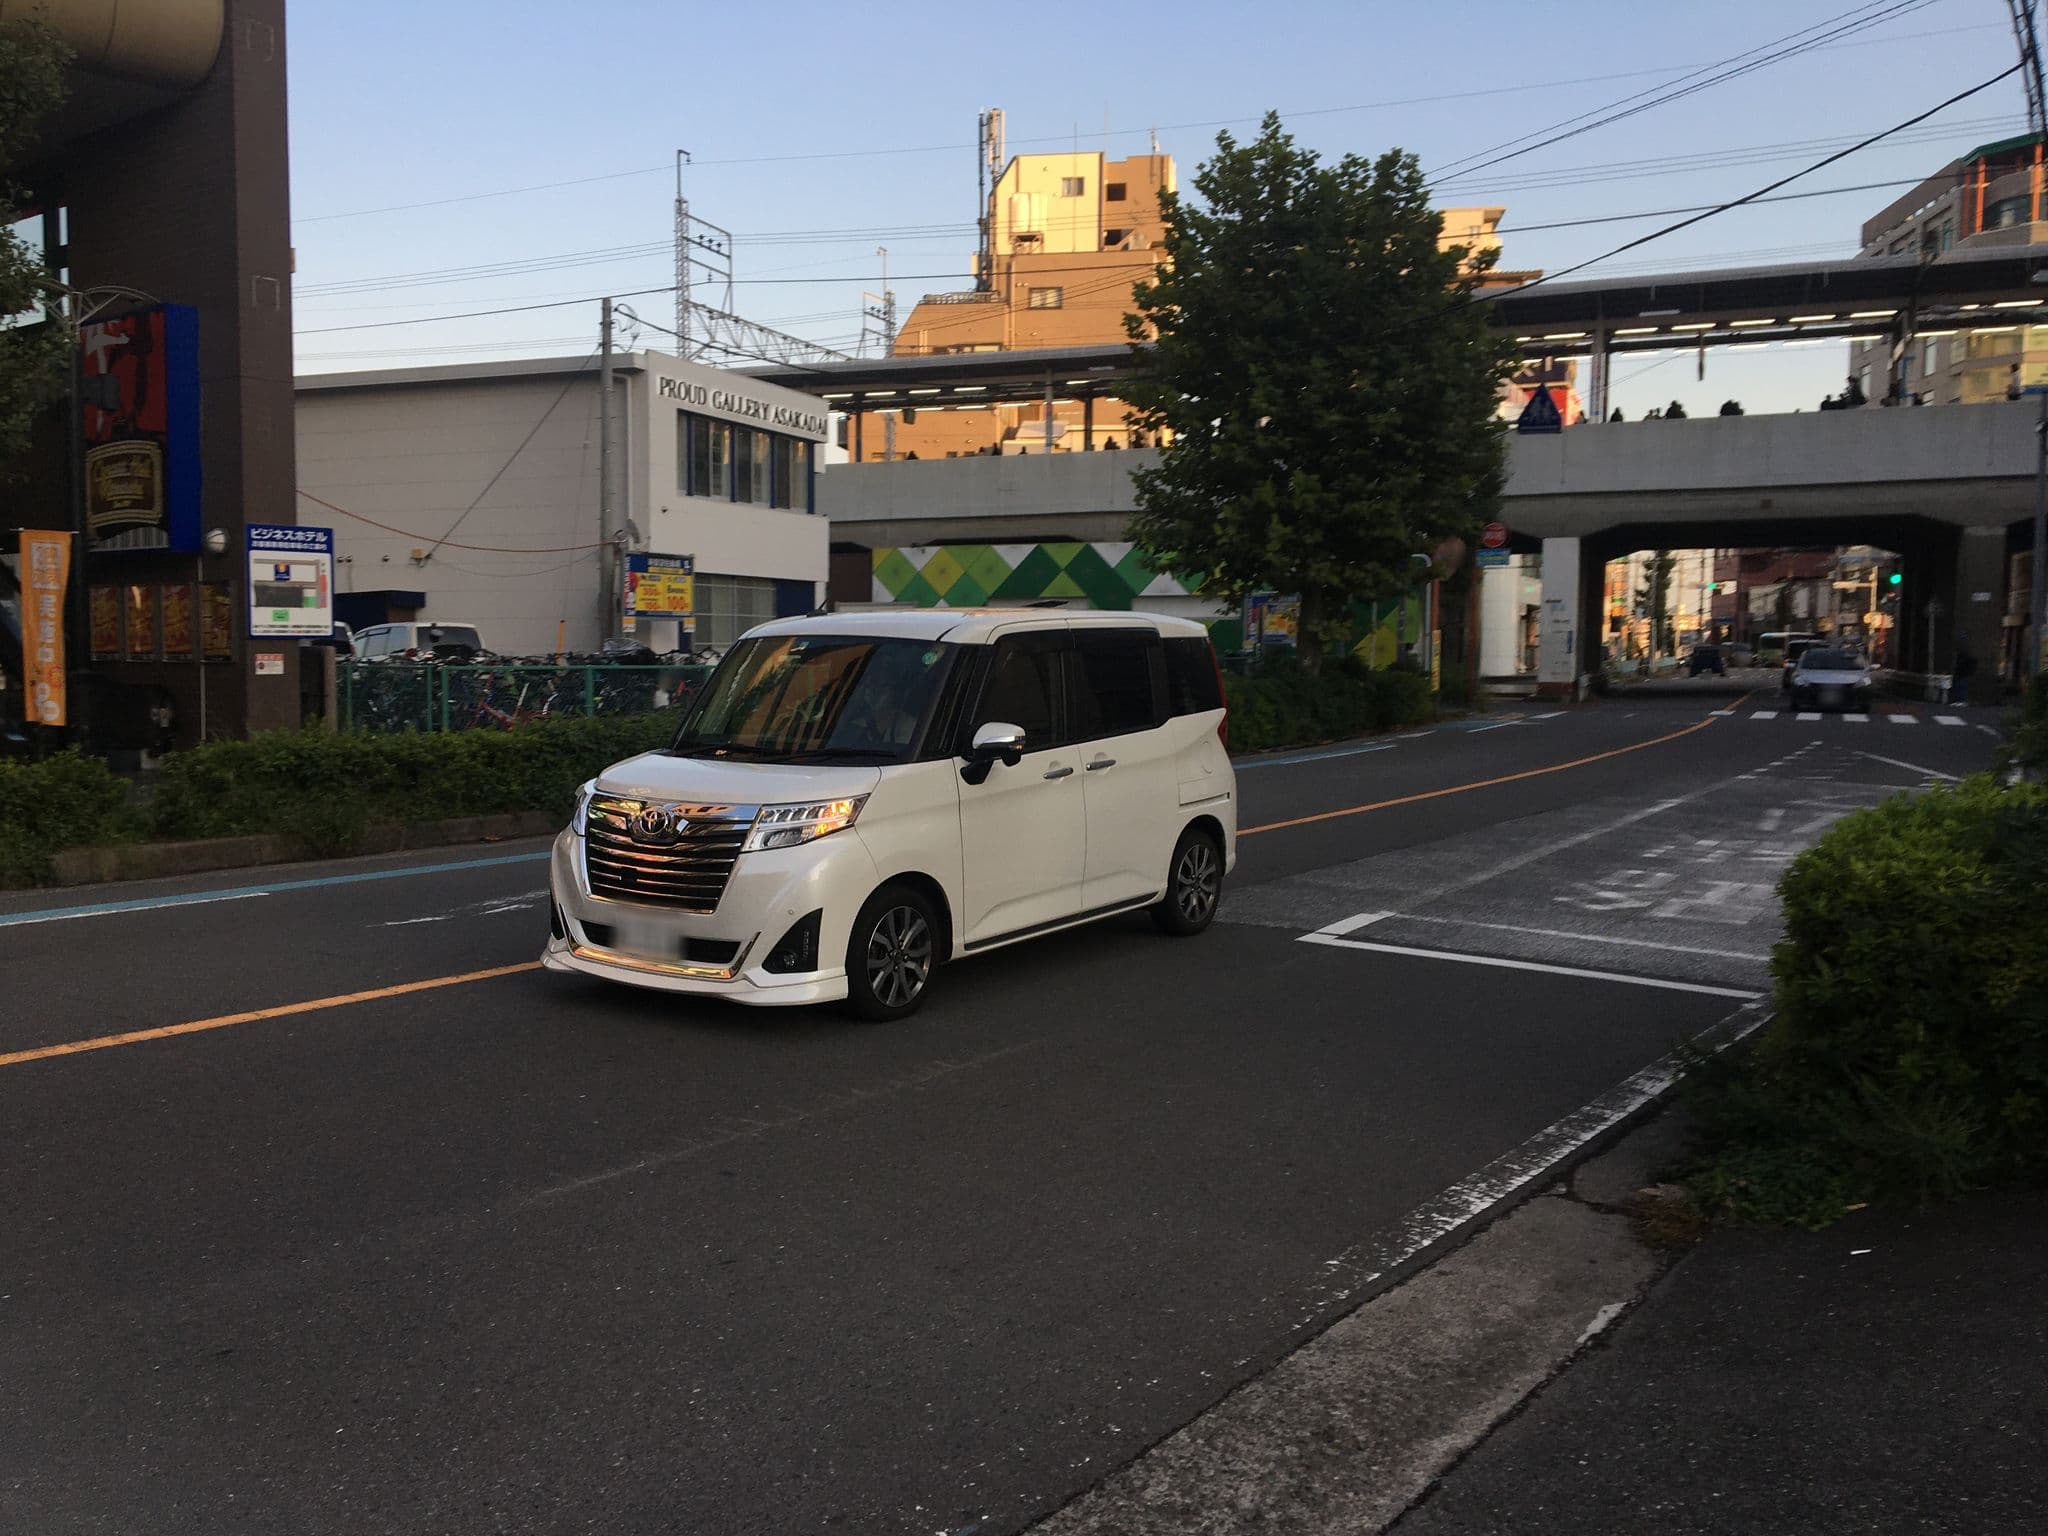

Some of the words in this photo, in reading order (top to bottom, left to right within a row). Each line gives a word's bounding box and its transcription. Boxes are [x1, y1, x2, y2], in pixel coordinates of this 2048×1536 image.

[658, 376, 707, 406] PROUD
[711, 390, 770, 421] GALLERY
[772, 405, 828, 435] ASAKADAI
[250, 527, 329, 542] ビジネスホテル
